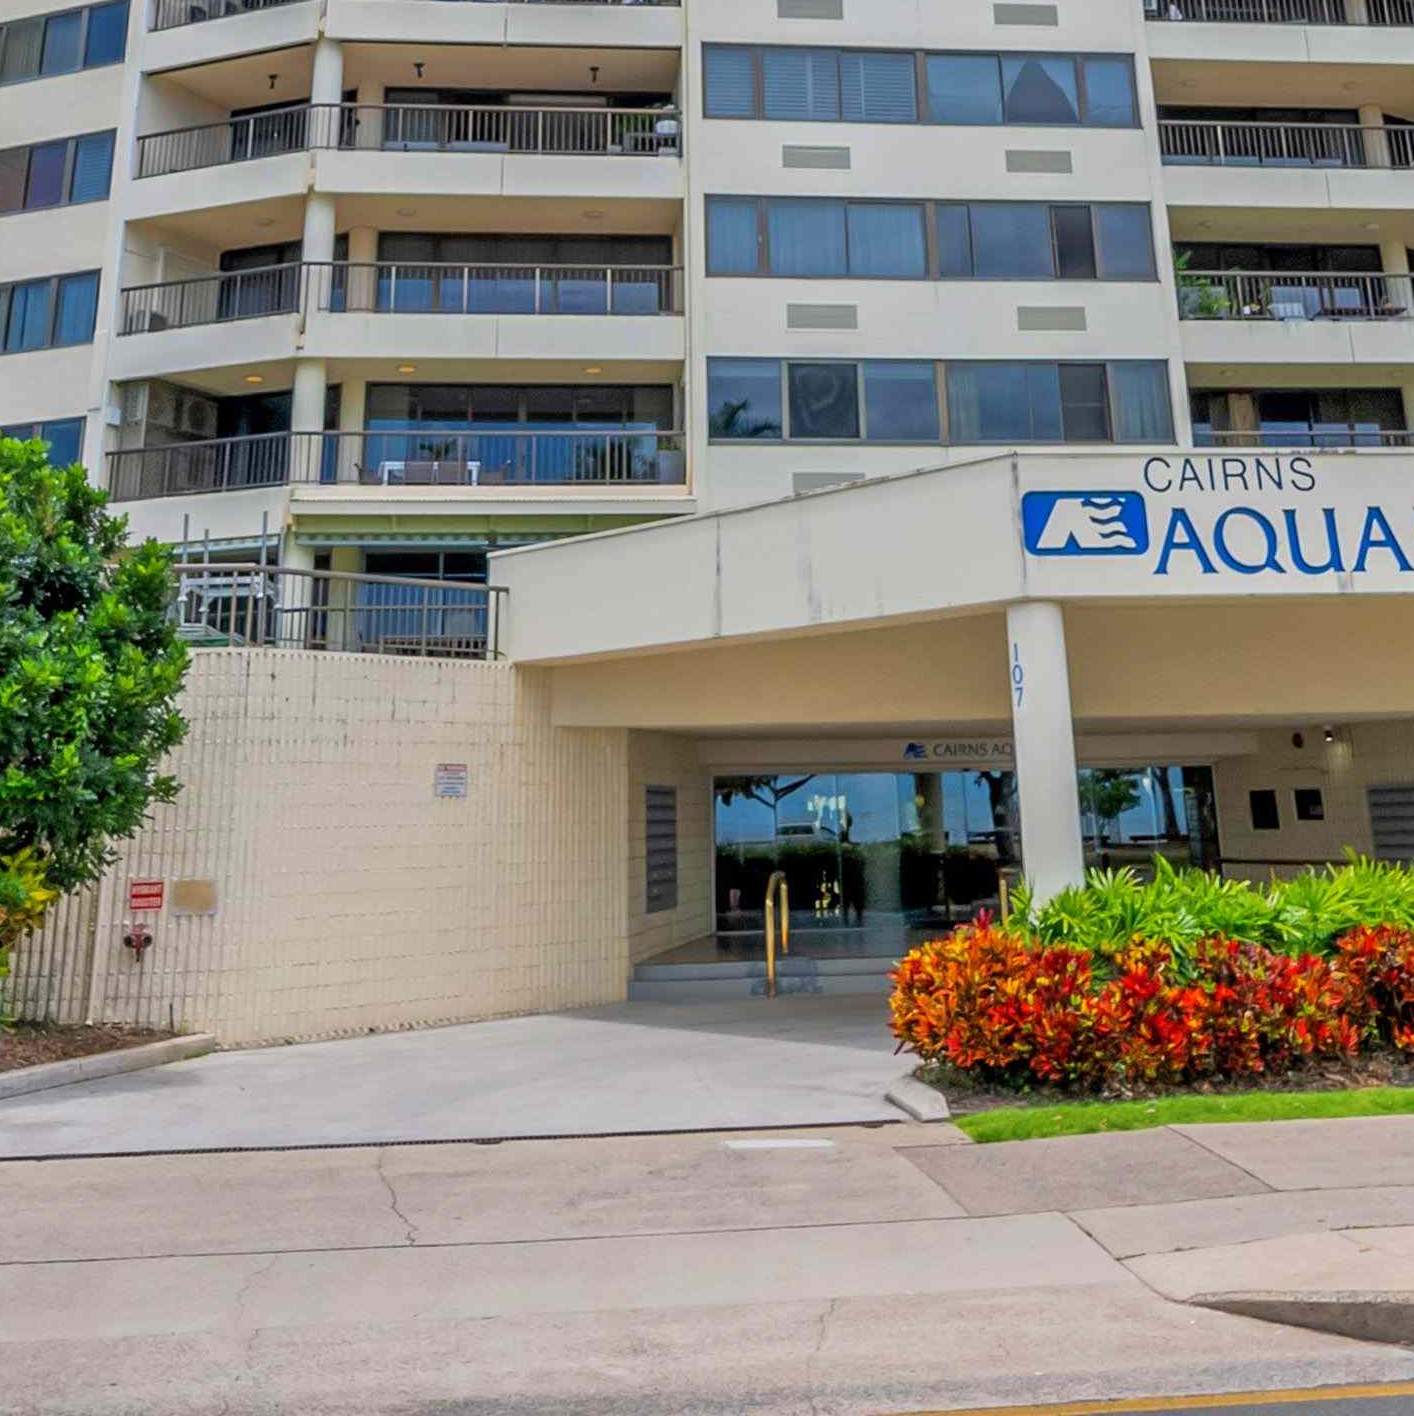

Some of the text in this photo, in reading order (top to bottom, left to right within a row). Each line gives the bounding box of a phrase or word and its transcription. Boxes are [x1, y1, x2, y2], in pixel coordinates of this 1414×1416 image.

[1143, 456, 1317, 492] CAIRNS
[1012, 642, 1024, 708] 107
[933, 742, 988, 757] CAIRNS
